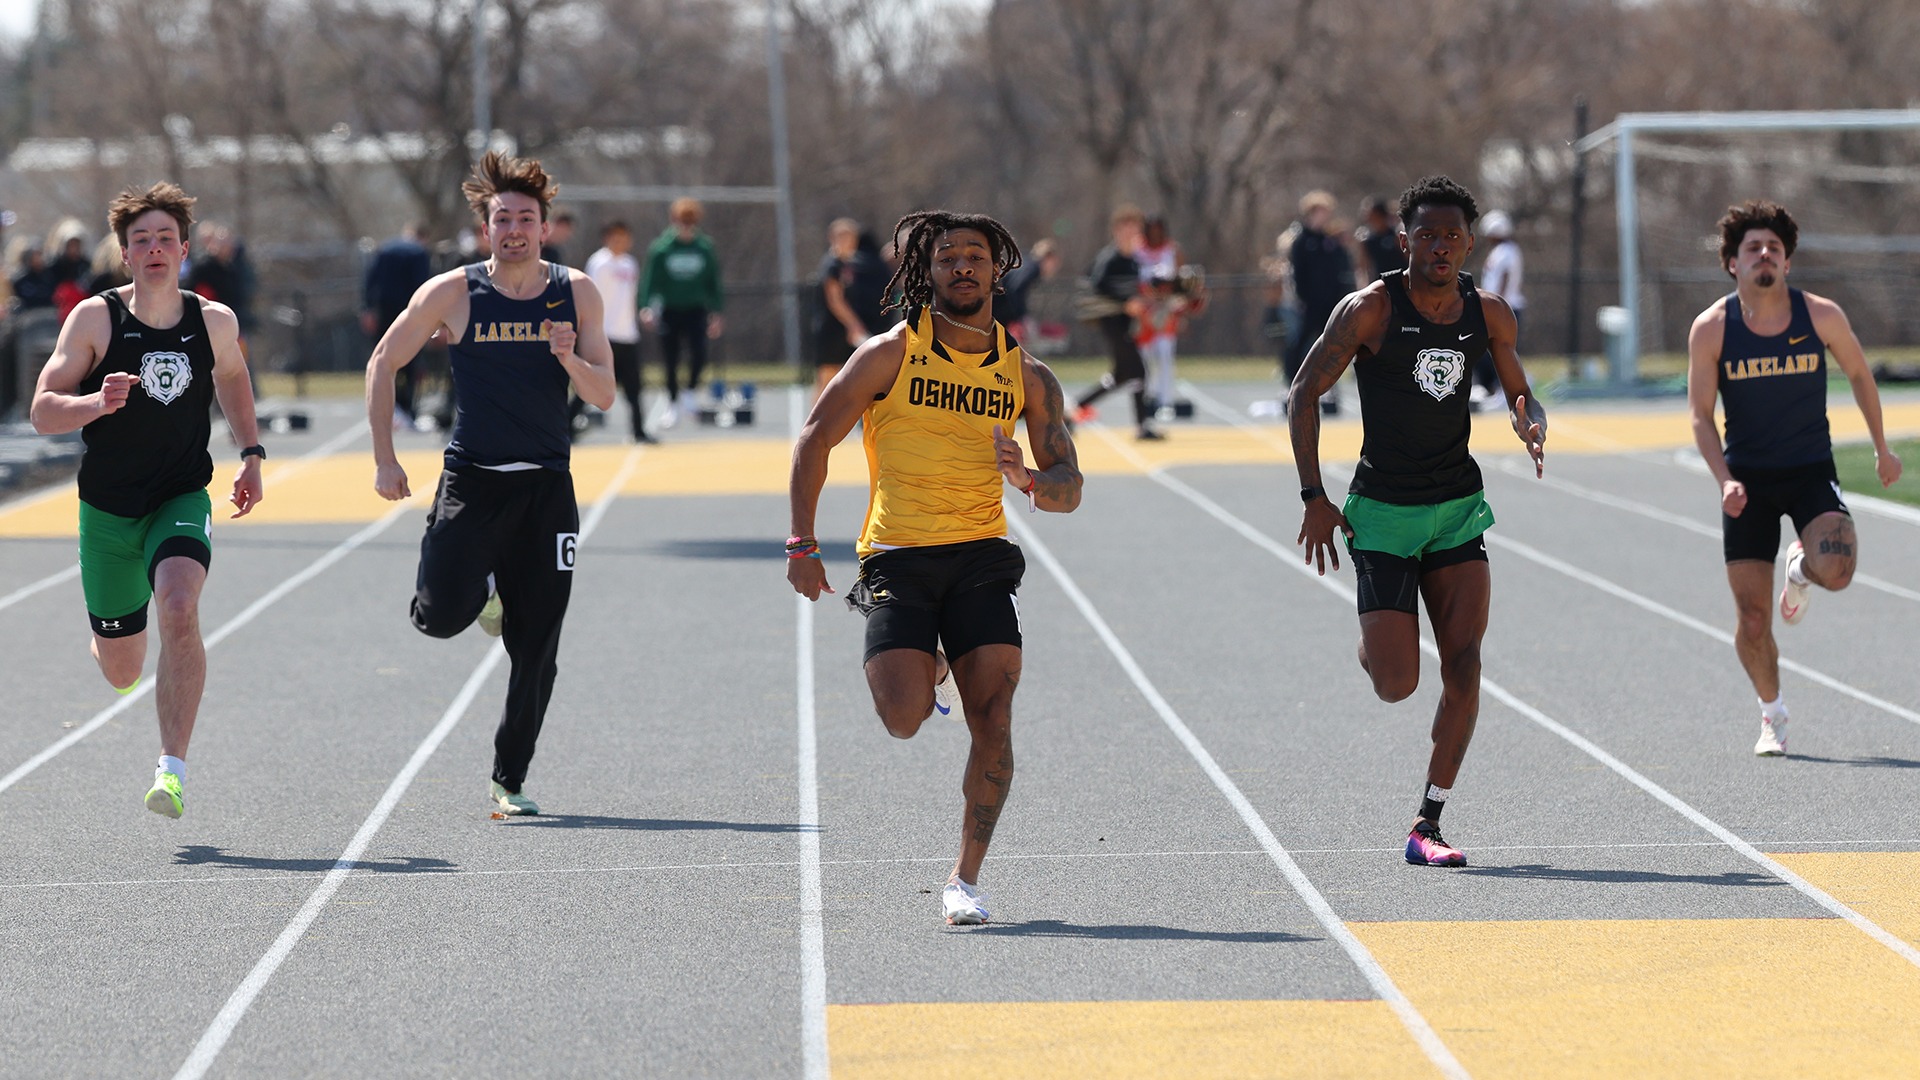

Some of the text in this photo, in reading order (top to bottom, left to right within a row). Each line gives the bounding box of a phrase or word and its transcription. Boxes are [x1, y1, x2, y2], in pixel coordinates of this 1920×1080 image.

[474, 321, 573, 342] LAKELA
[1724, 353, 1819, 380] LAKELAND
[909, 377, 1015, 420] OSHKOSH
[561, 535, 576, 568] 6
